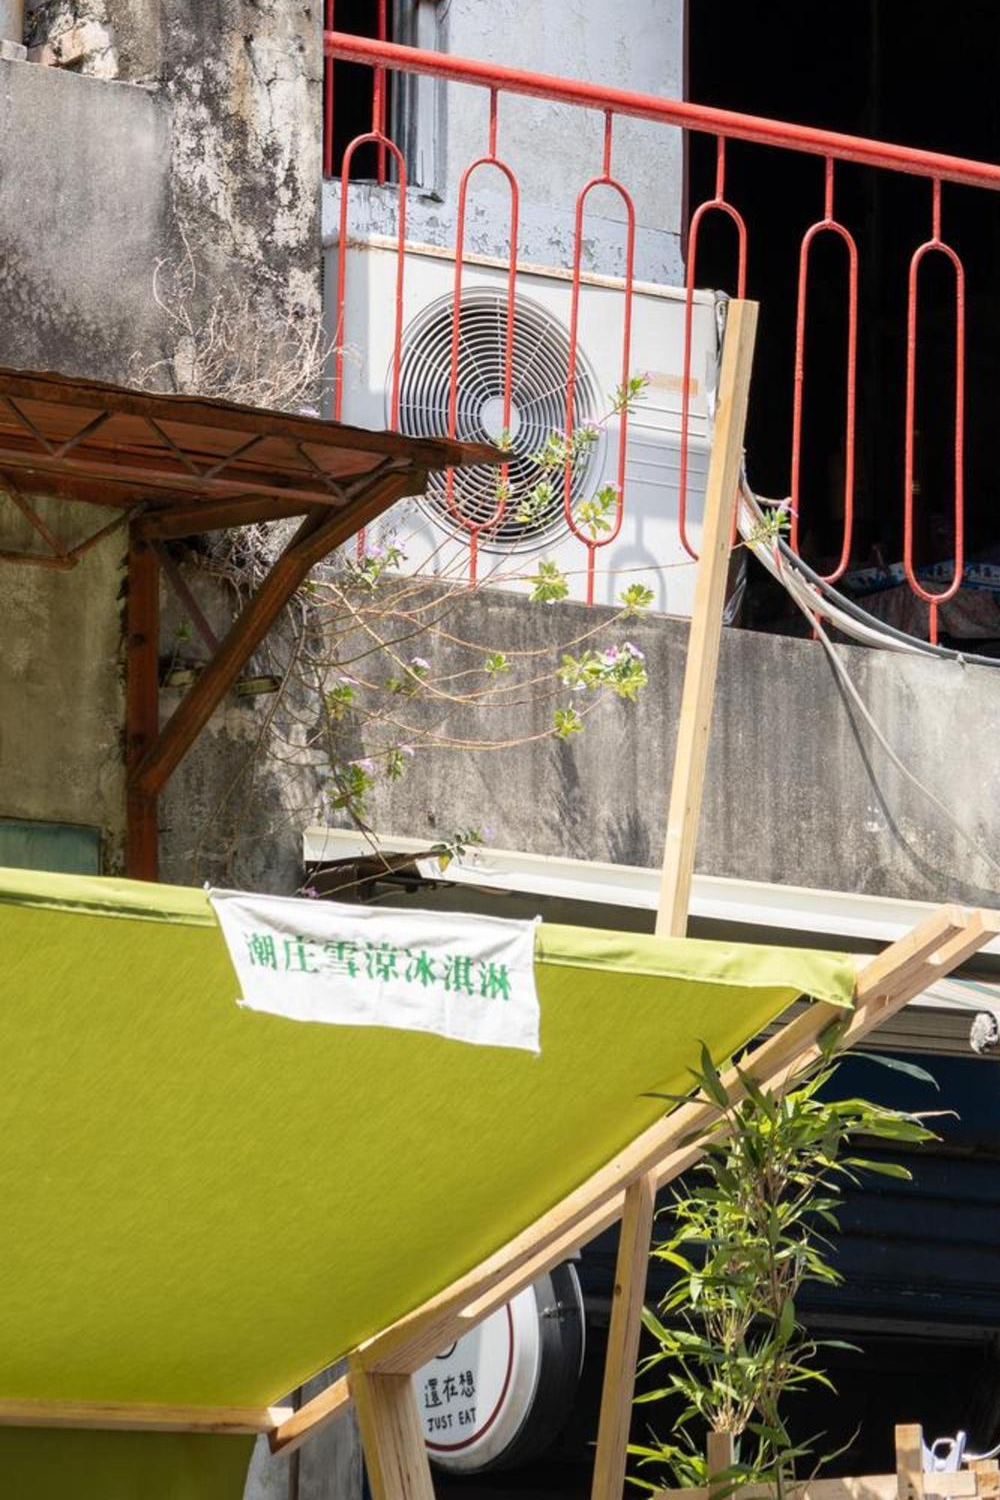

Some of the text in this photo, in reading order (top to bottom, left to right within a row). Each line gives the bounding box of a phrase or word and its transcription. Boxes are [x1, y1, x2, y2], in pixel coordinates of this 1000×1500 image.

[244, 932, 513, 1001] 潮庄雪涼冰淇淋
[424, 1369, 477, 1409] 還在想
[427, 1407, 478, 1432] JUST EAT
